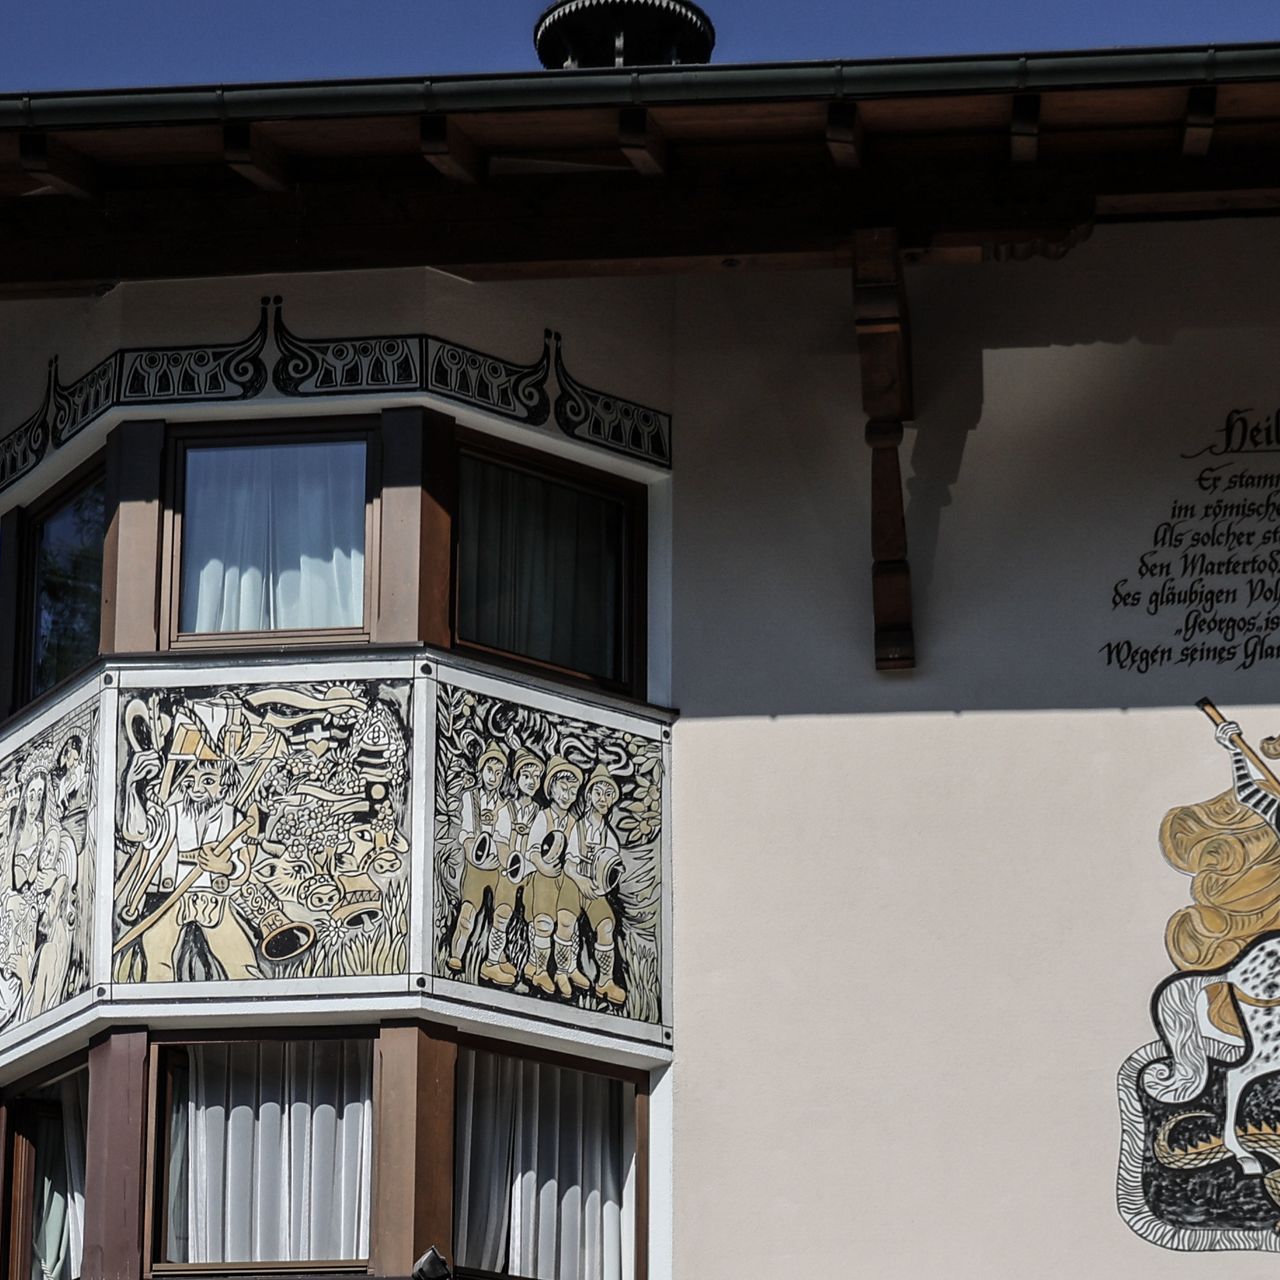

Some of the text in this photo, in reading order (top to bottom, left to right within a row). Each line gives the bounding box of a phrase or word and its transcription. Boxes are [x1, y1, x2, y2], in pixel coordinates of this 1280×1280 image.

[1197, 463, 1232, 493] Er
[1171, 498, 1195, 519] im
[1154, 522, 1188, 548] Als
[1185, 520, 1255, 550] solcher
[1138, 551, 1170, 578] den
[1112, 579, 1141, 608] des
[1146, 579, 1237, 614] gläubigen
[1098, 640, 1172, 673] Wegen
[1176, 642, 1238, 664] seines
